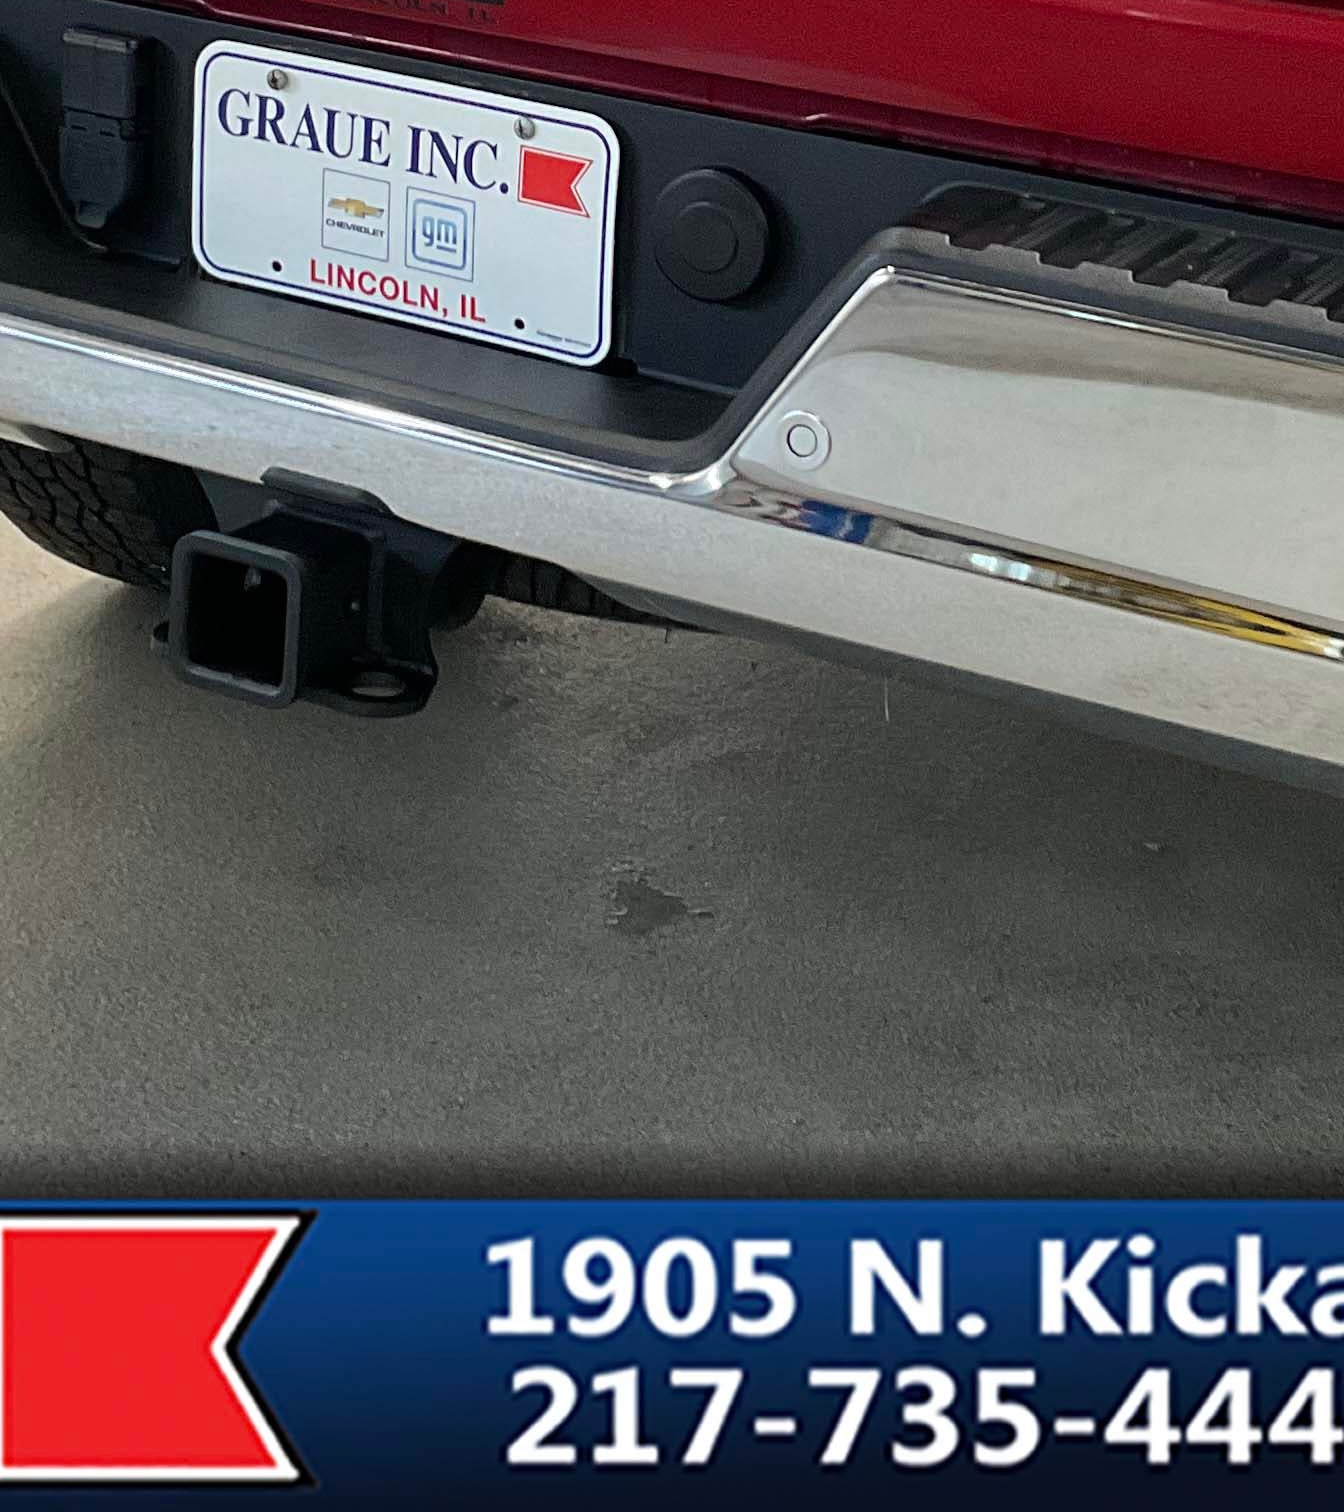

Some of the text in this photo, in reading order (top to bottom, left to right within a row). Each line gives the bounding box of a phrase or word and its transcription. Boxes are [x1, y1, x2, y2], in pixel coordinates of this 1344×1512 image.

[217, 88, 509, 195] GRAUE INC.
[325, 218, 385, 238] CHEVROLET
[422, 215, 457, 253] gm
[309, 258, 486, 322] LINCOLN, IL
